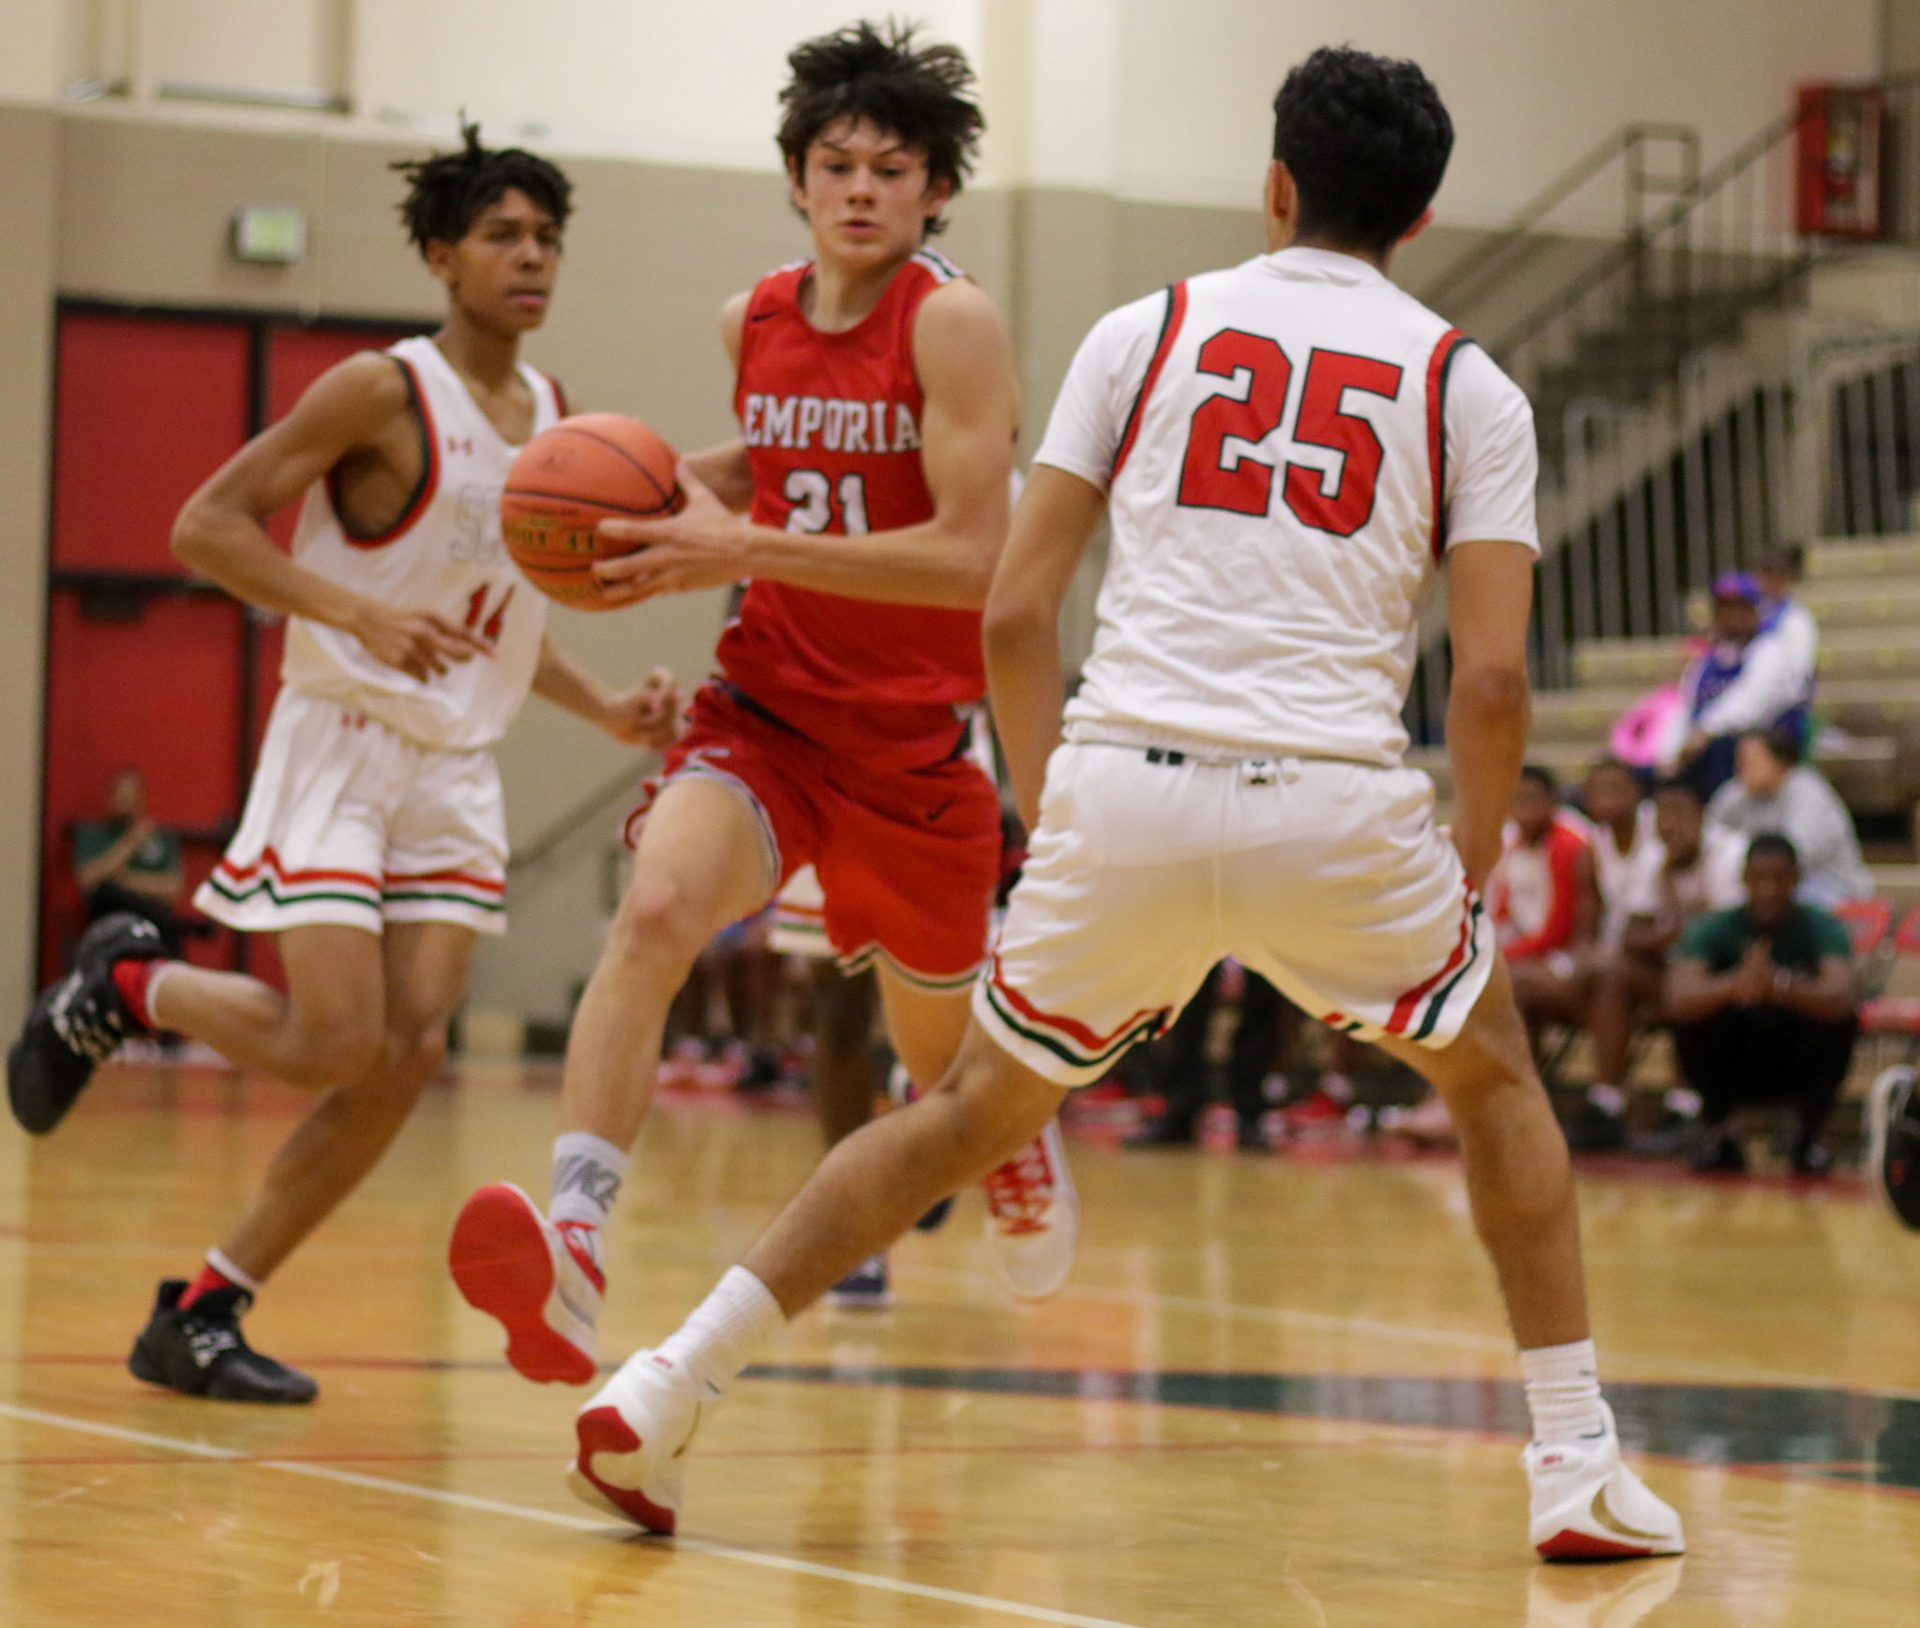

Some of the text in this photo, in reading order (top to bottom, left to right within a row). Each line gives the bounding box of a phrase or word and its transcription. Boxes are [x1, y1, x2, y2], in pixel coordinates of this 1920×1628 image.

[745, 393, 922, 454] EMPORIA
[1177, 327, 1404, 538] 25
[784, 468, 869, 536] 21
